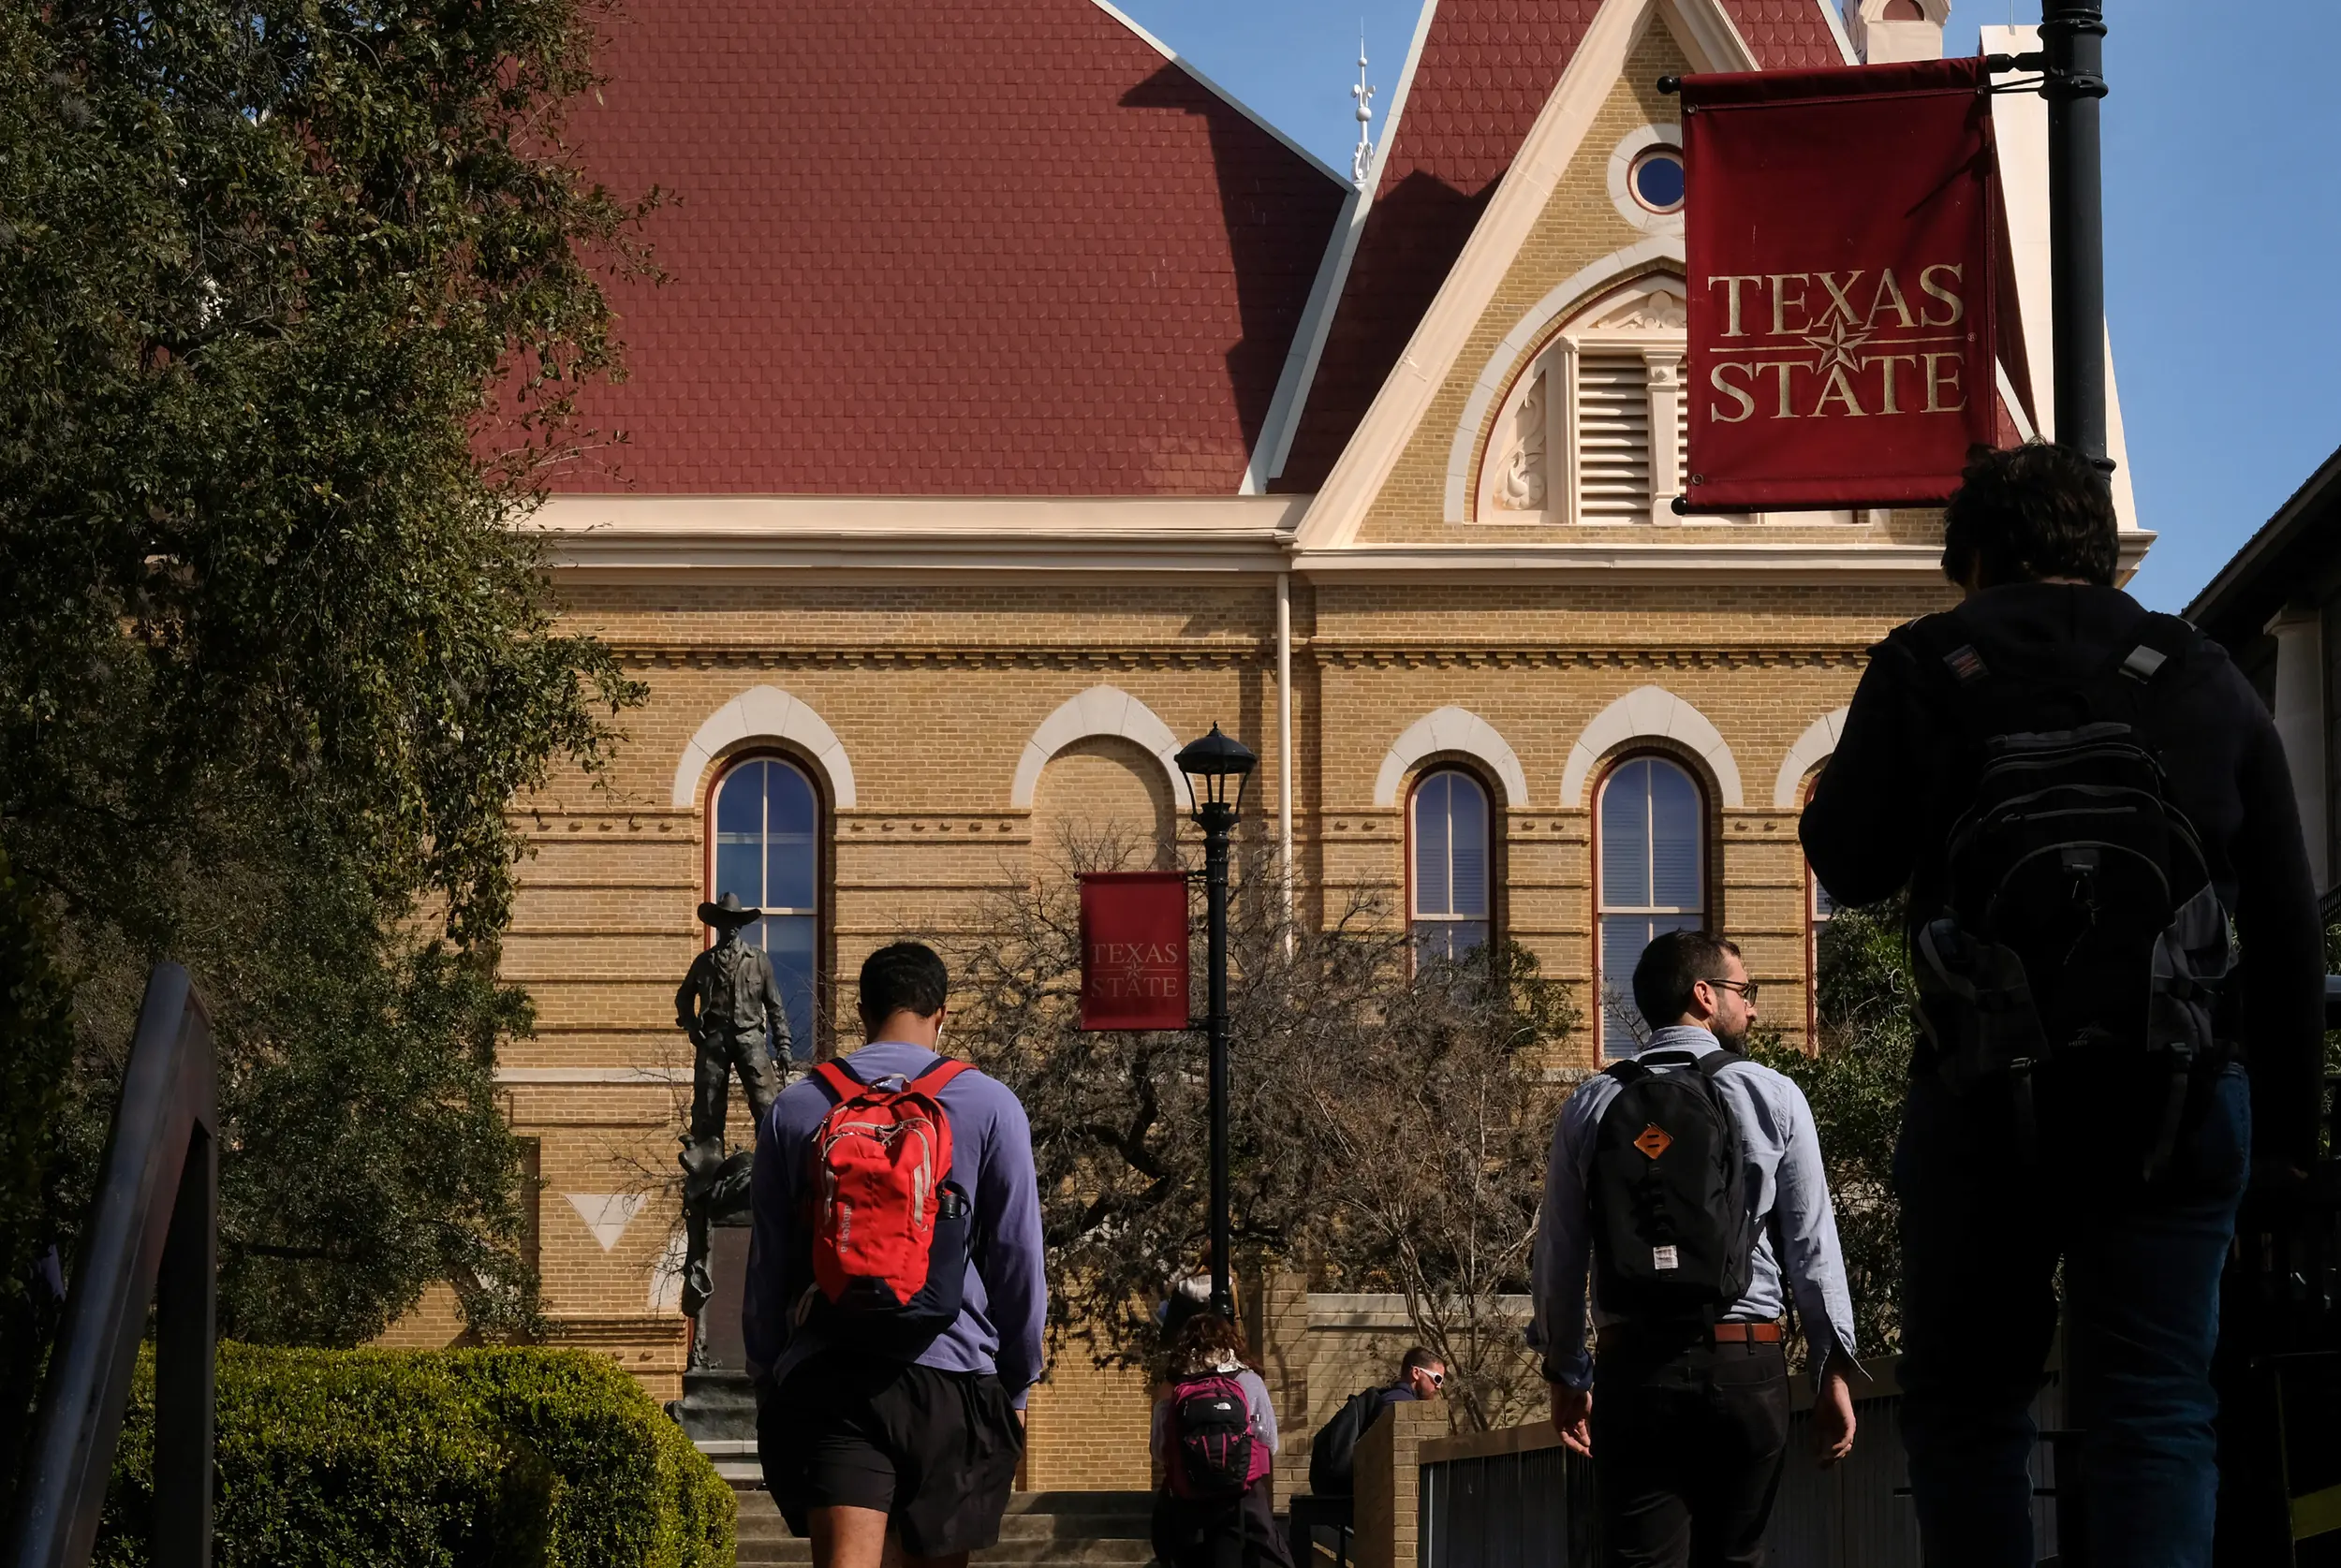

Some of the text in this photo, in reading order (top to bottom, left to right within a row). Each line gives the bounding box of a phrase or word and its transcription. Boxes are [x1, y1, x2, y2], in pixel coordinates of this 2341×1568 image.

[1708, 263, 1964, 337] TEXAS
[1710, 352, 1967, 423] STATE
[1090, 943, 1178, 964] TEXAS
[1091, 977, 1178, 998] STATE
